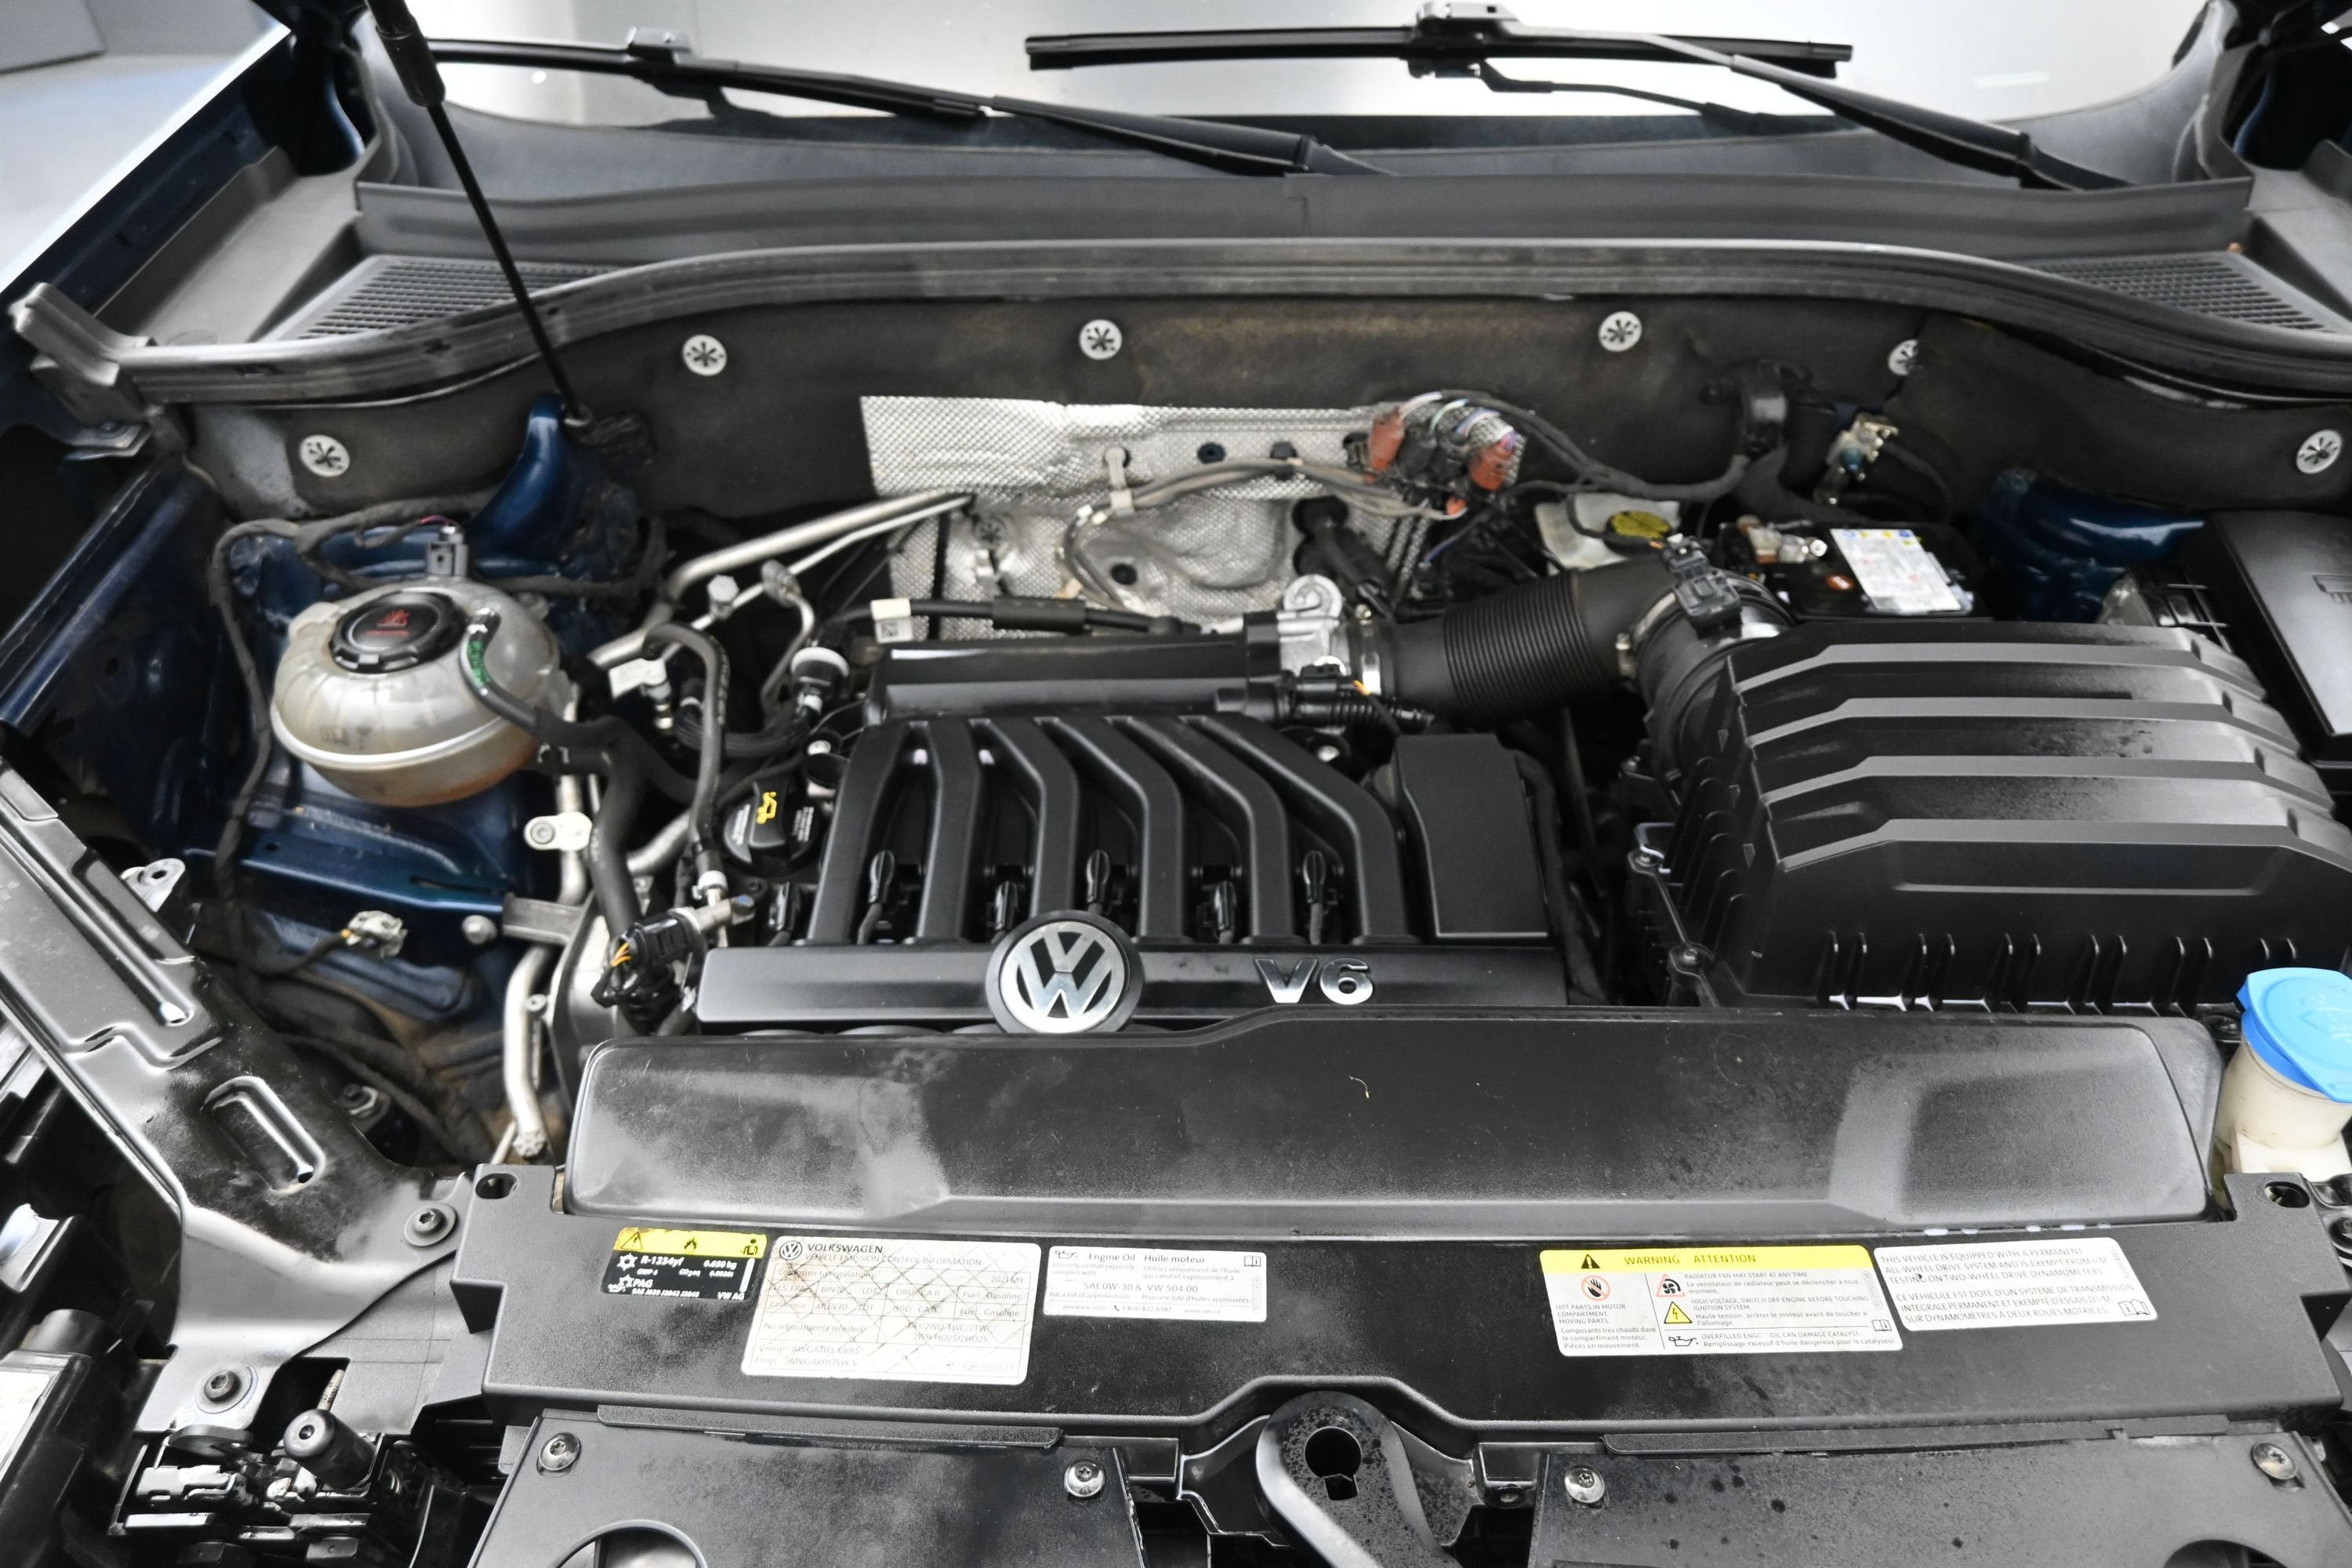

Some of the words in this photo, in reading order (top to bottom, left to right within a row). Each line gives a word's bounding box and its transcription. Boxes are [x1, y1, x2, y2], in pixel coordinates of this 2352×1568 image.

[1255, 957, 1373, 1005] V6
[808, 1243, 883, 1254] VOLKSWAGEN
[1950, 1251, 1994, 1261] EQUIPPED
[2030, 1247, 2082, 1257] PERMANENT
[840, 1254, 880, 1263] EMISSION
[923, 1257, 982, 1265] INFORMATION
[1089, 1253, 1120, 1263] Engine
[1624, 1255, 1680, 1265] WARNING
[1693, 1254, 1756, 1263] ATTENTION
[1886, 1264, 1933, 1273] ALL-WHEEL
[1936, 1263, 1961, 1272] DRIVE
[1964, 1261, 1997, 1270] SYSTEM
[2030, 1258, 2063, 1267] EXEMPT
[633, 1279, 653, 1288] PAG
[1889, 1276, 1926, 1284] TESTING
[1944, 1272, 2000, 1281] TWO-WHEEL
[1166, 1284, 1183, 1293] 504
[2056, 1286, 2070, 1294] DE
[2070, 1283, 2134, 1294] TRANSMISSION
[731, 1292, 745, 1301] AG
[986, 1291, 1022, 1300] Gasoline
[1948, 1301, 1999, 1310] PERMANENT
[2002, 1299, 2012, 1308] ET
[985, 1308, 1020, 1317] Gasoline
[1905, 1315, 1922, 1323] SUR
[2007, 1309, 2031, 1318] DEUX
[2033, 1308, 2063, 1317] ROUES
[778, 1323, 830, 1333] adjustments
